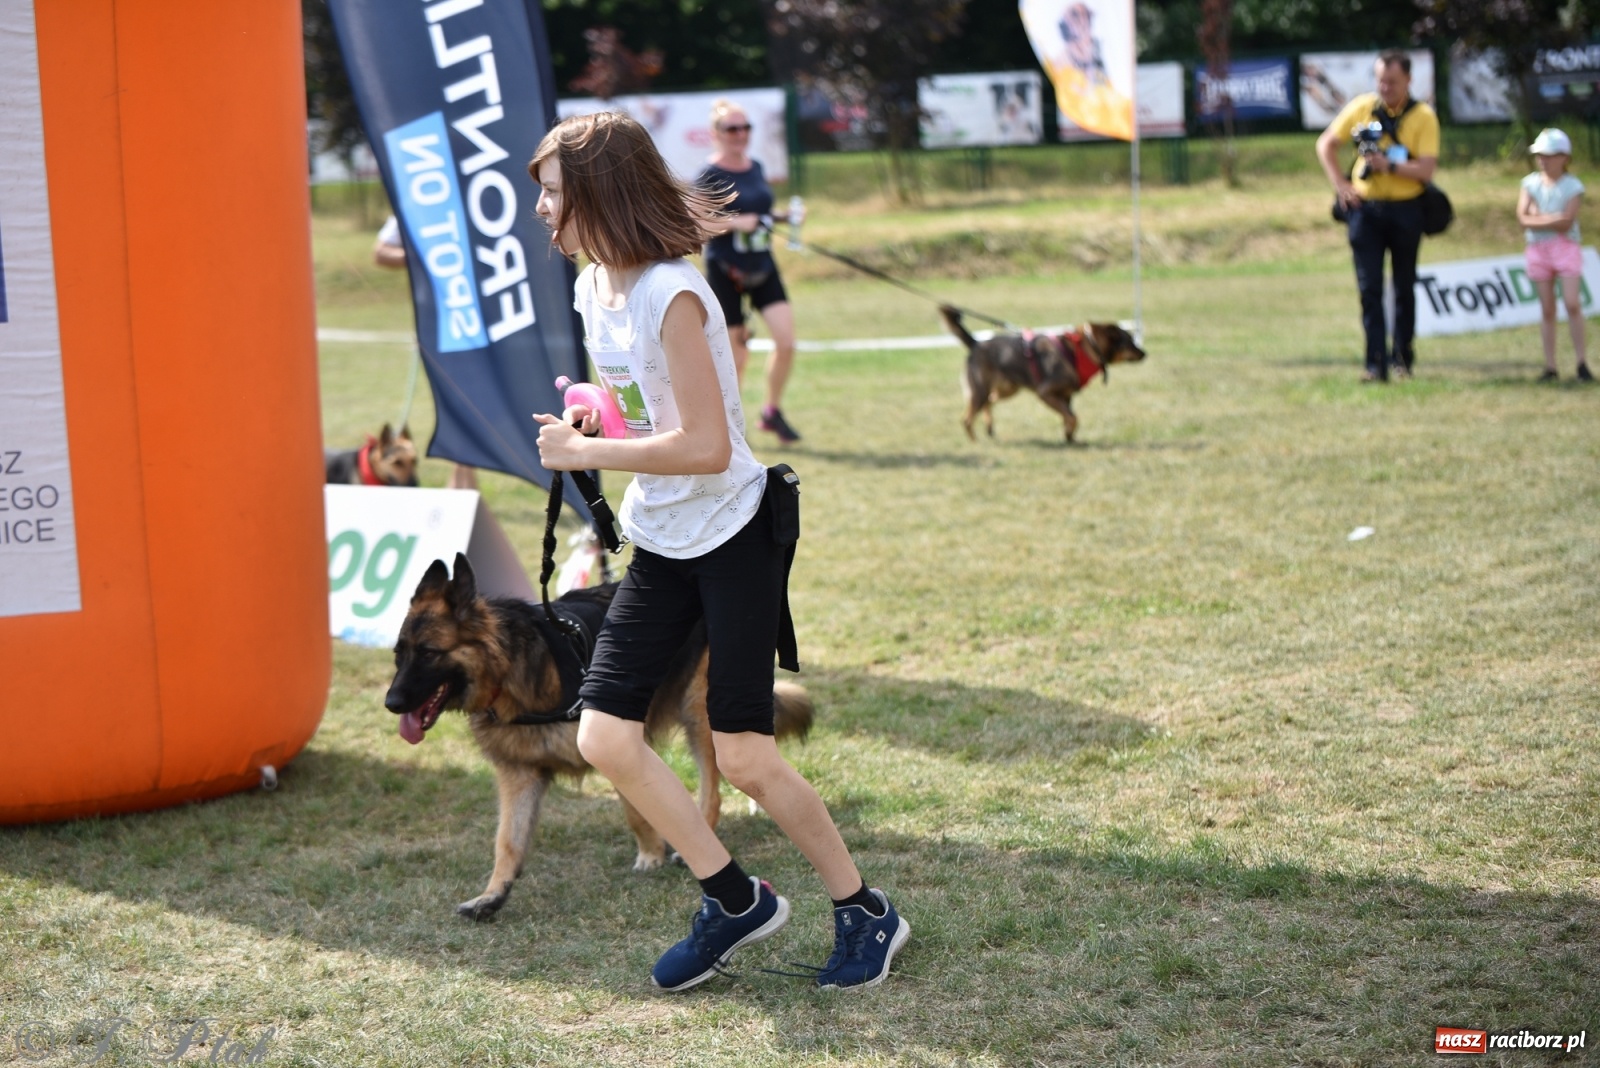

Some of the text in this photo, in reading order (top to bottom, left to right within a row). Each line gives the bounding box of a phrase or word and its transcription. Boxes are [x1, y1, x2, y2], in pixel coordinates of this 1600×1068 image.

[617, 393, 627, 412] 6
[0, 450, 25, 475] Z
[0, 518, 57, 545] ICE
